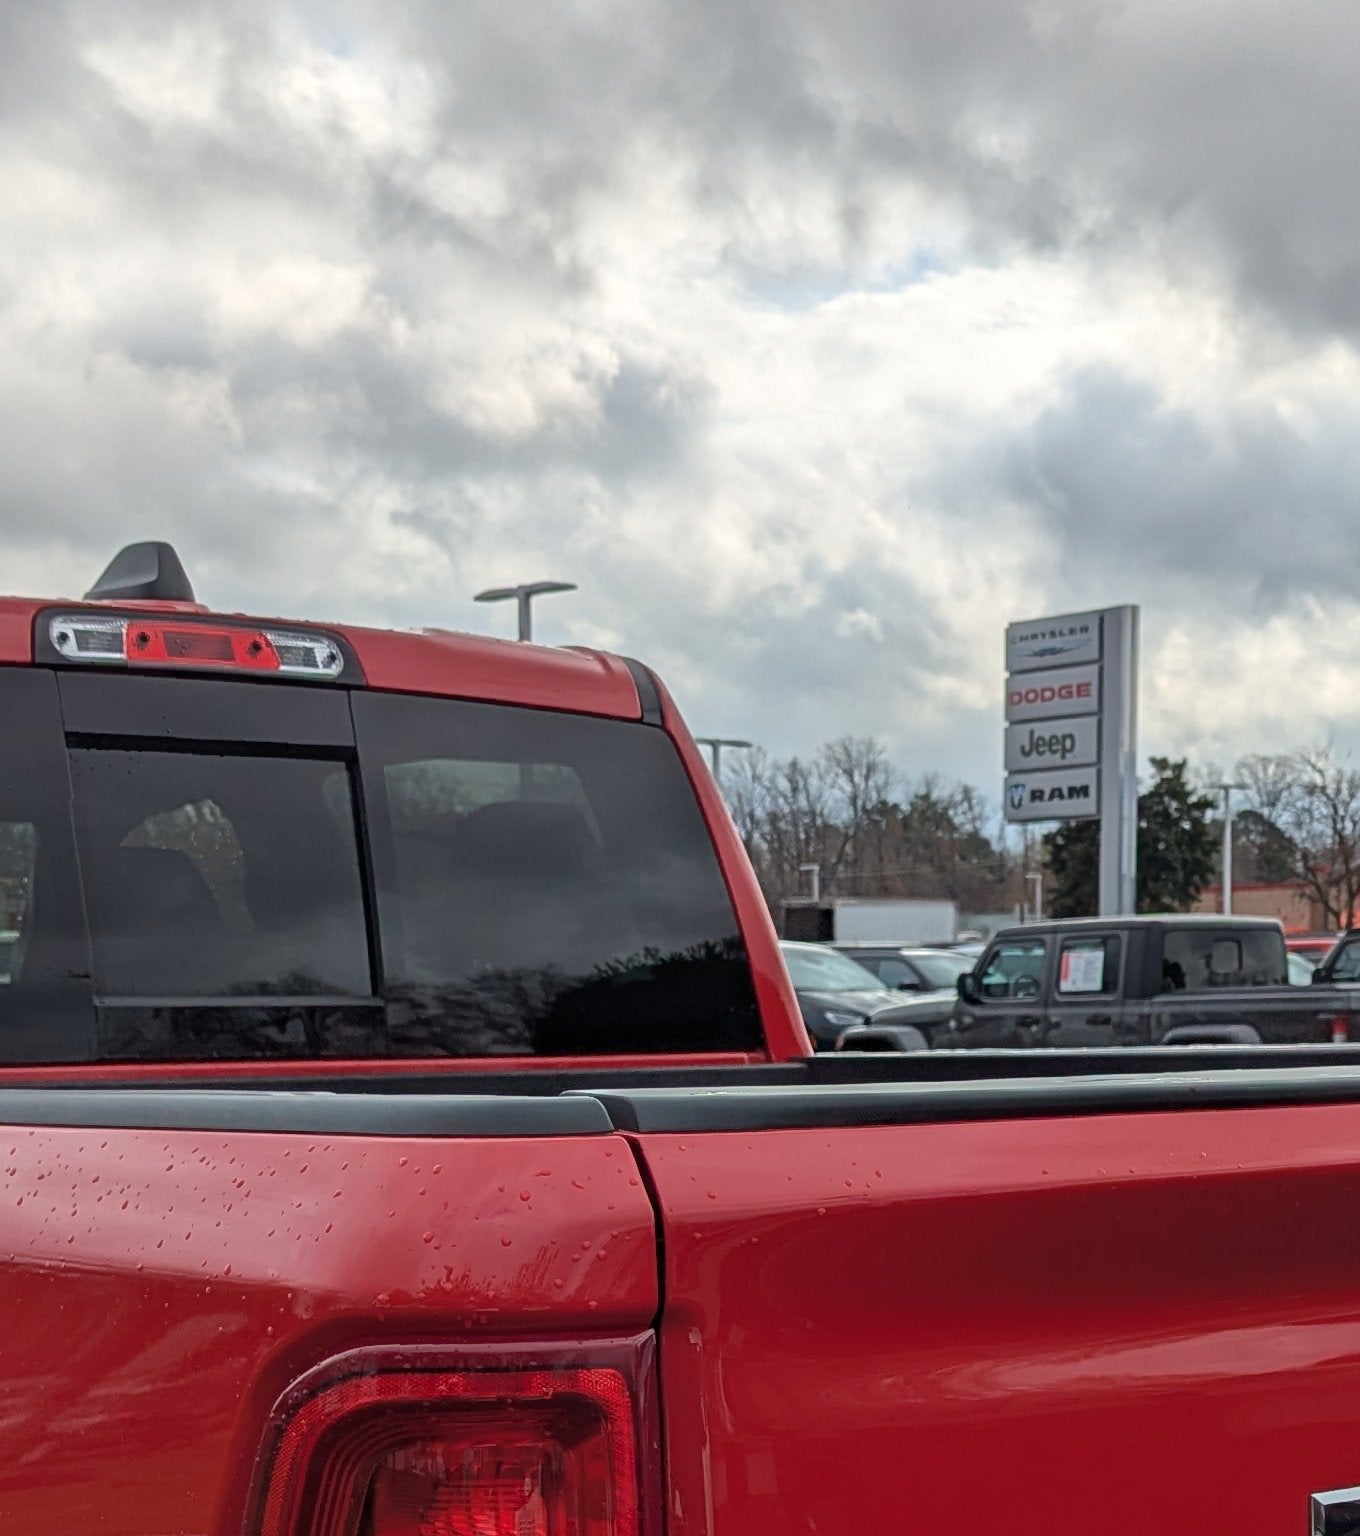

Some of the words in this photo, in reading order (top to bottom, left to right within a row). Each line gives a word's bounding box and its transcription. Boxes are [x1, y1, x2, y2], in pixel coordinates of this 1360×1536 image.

[1011, 625, 1090, 645] CHRYSLER
[1009, 681, 1092, 706] DODGE
[1020, 729, 1076, 760] Jeep
[1029, 784, 1090, 803] RAM
